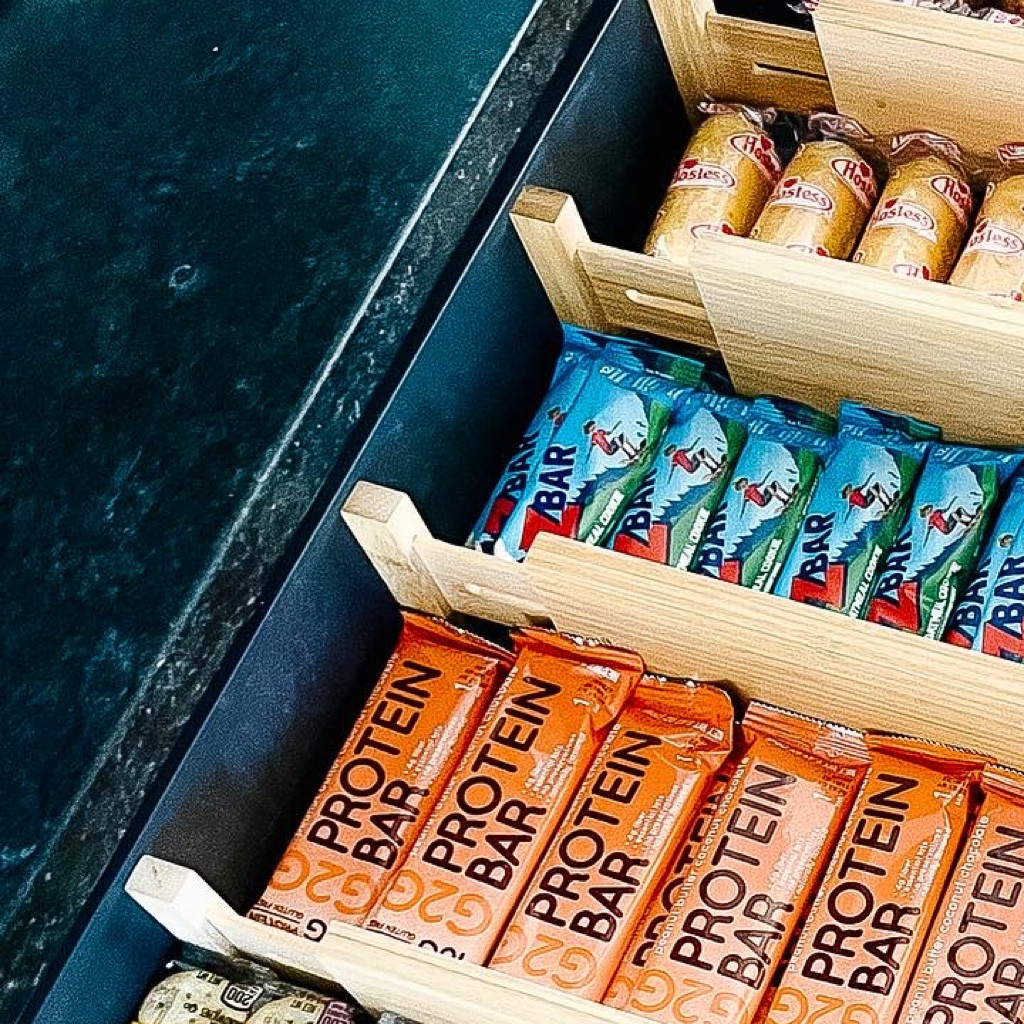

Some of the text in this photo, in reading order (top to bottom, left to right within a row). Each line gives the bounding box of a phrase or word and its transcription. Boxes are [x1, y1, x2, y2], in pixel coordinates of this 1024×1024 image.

[306, 660, 442, 853] PROTEIN
[422, 676, 561, 874] PROTEIN
[351, 779, 430, 870] BAR
[465, 799, 547, 891] BAR
[525, 730, 662, 927] PROTEIN
[670, 764, 797, 970] PROTEIN
[270, 851, 379, 915] G2G
[381, 869, 492, 936] G2G
[569, 851, 650, 943] BAR
[801, 773, 921, 986] PROTEIN
[492, 925, 598, 989] G2G
[717, 893, 794, 991] BAR
[847, 902, 922, 996] BAR
[226, 987, 250, 1008] 200
